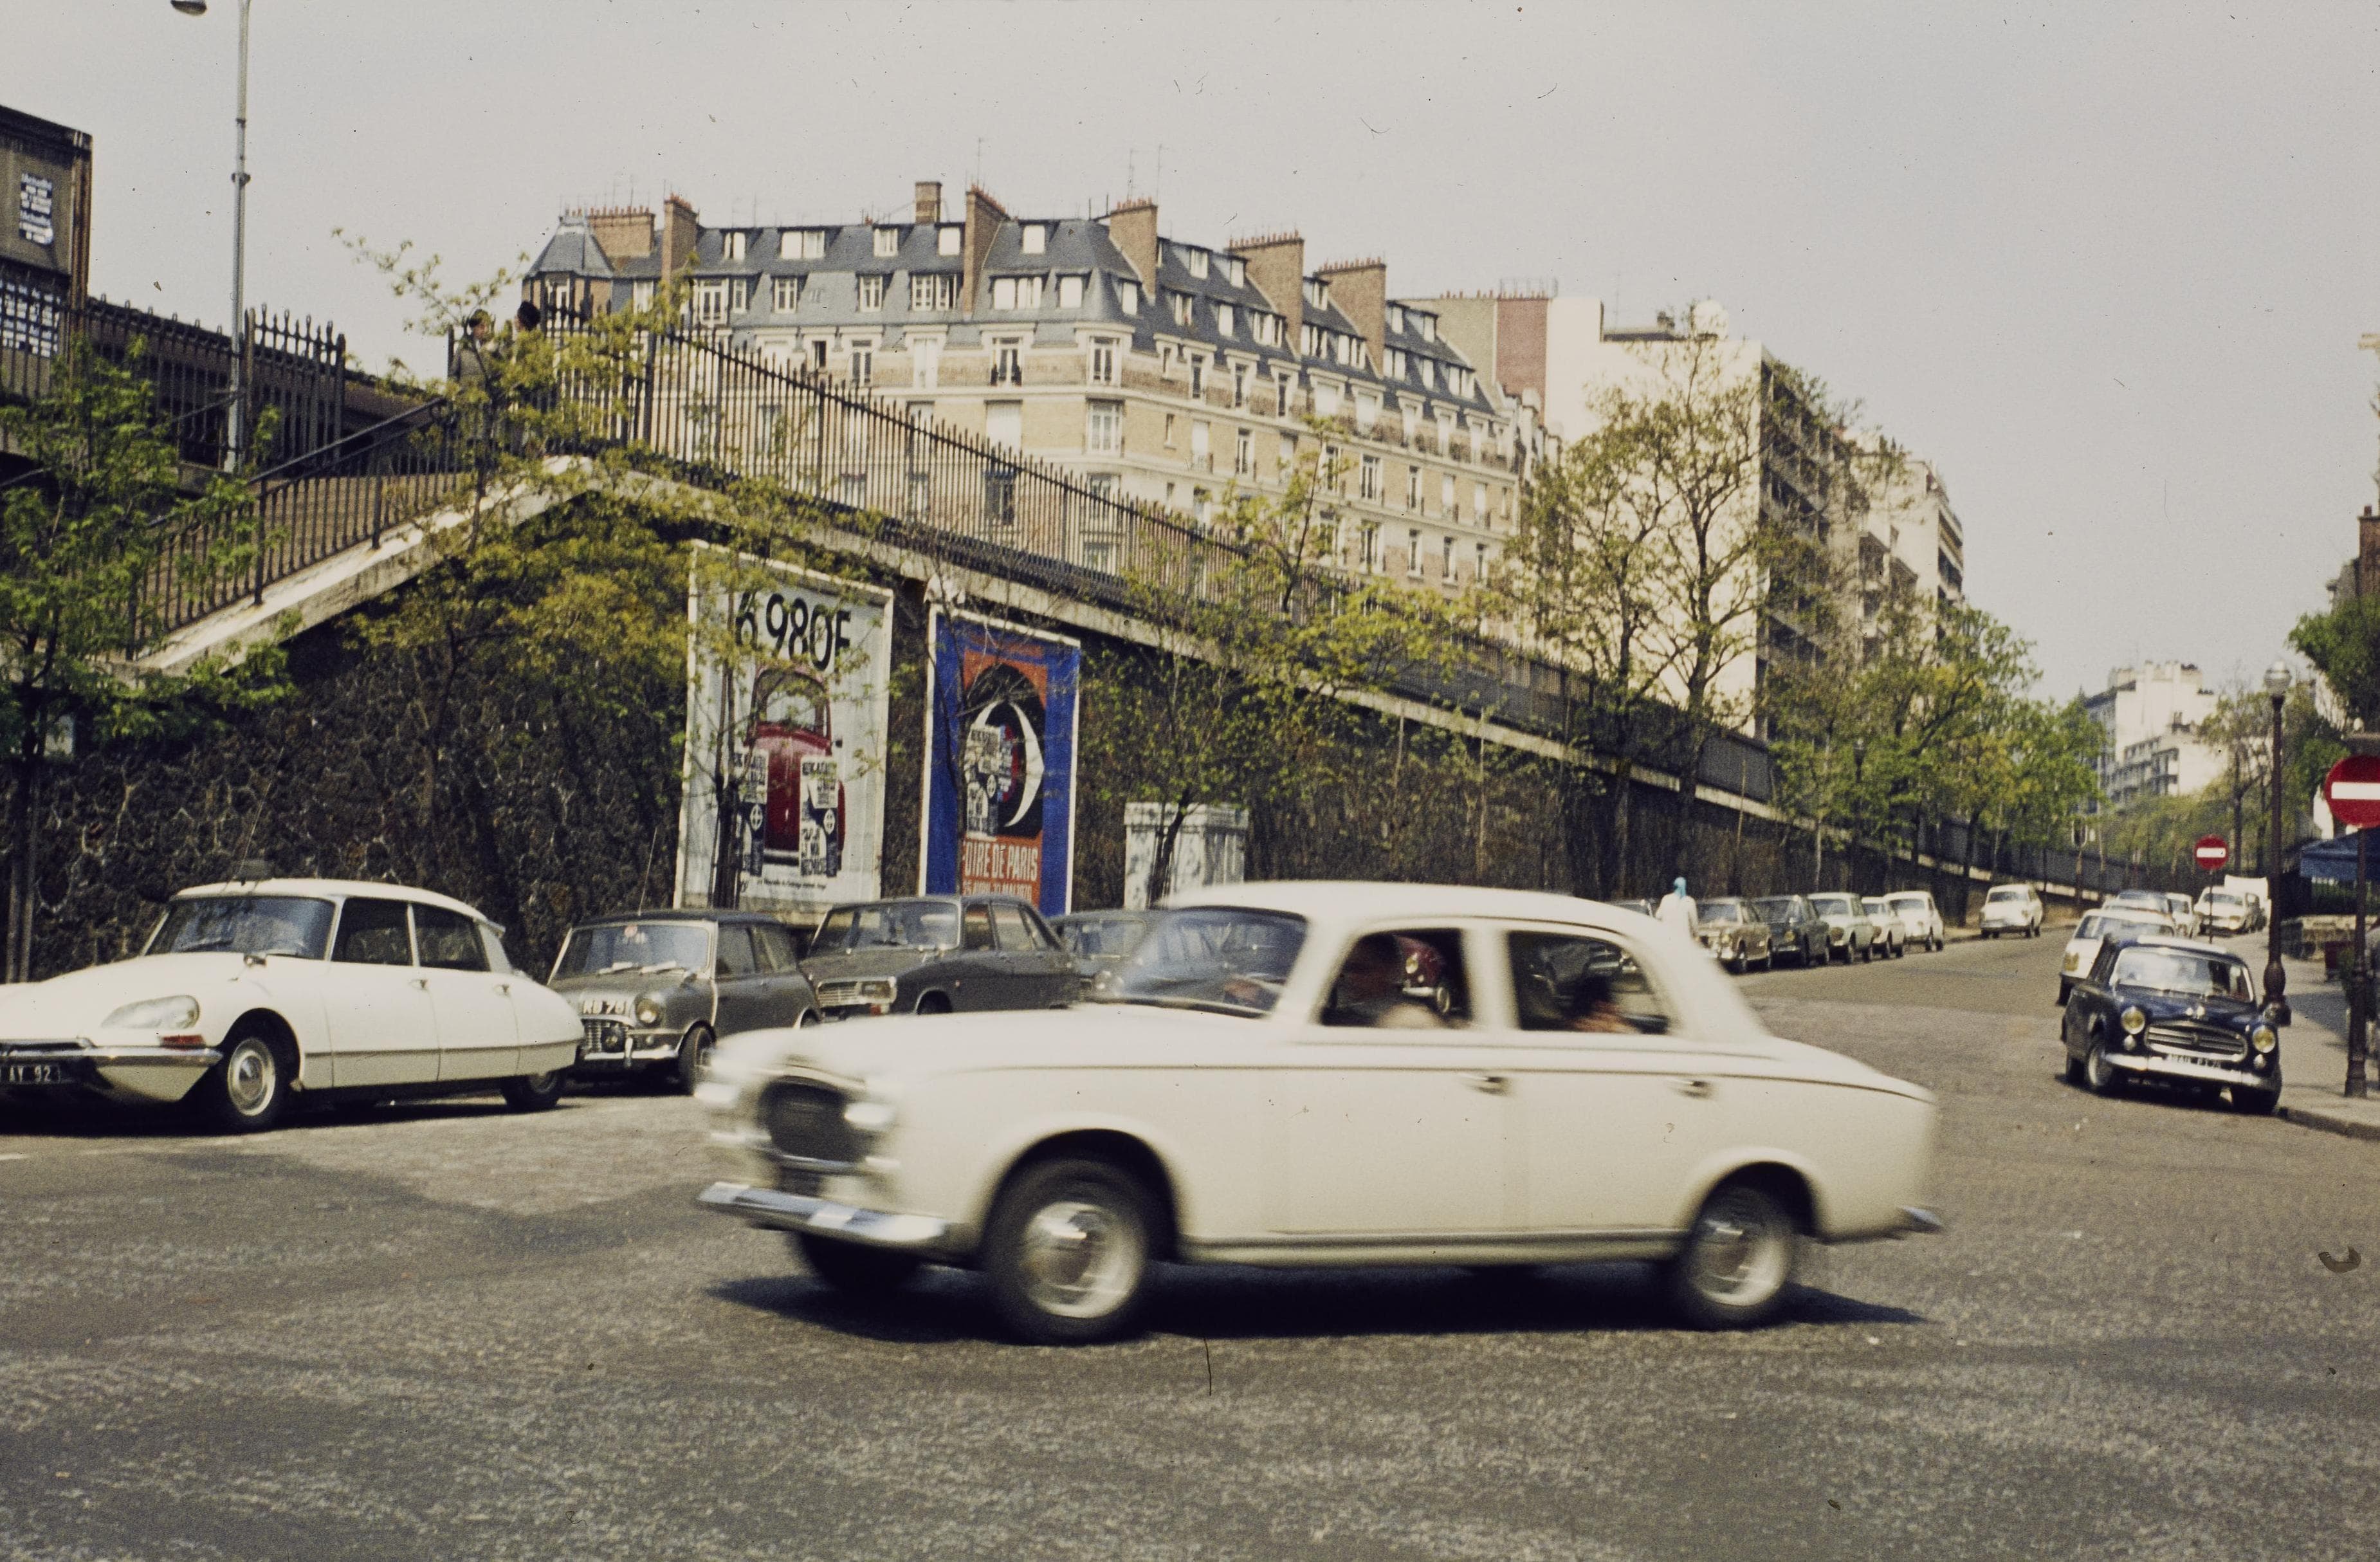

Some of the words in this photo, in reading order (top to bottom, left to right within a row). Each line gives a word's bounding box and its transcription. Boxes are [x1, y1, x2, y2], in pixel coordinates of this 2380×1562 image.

[991, 842, 1007, 879] DE
[1007, 843, 1039, 882] PARIS
[34, 1065, 51, 1082] 92
